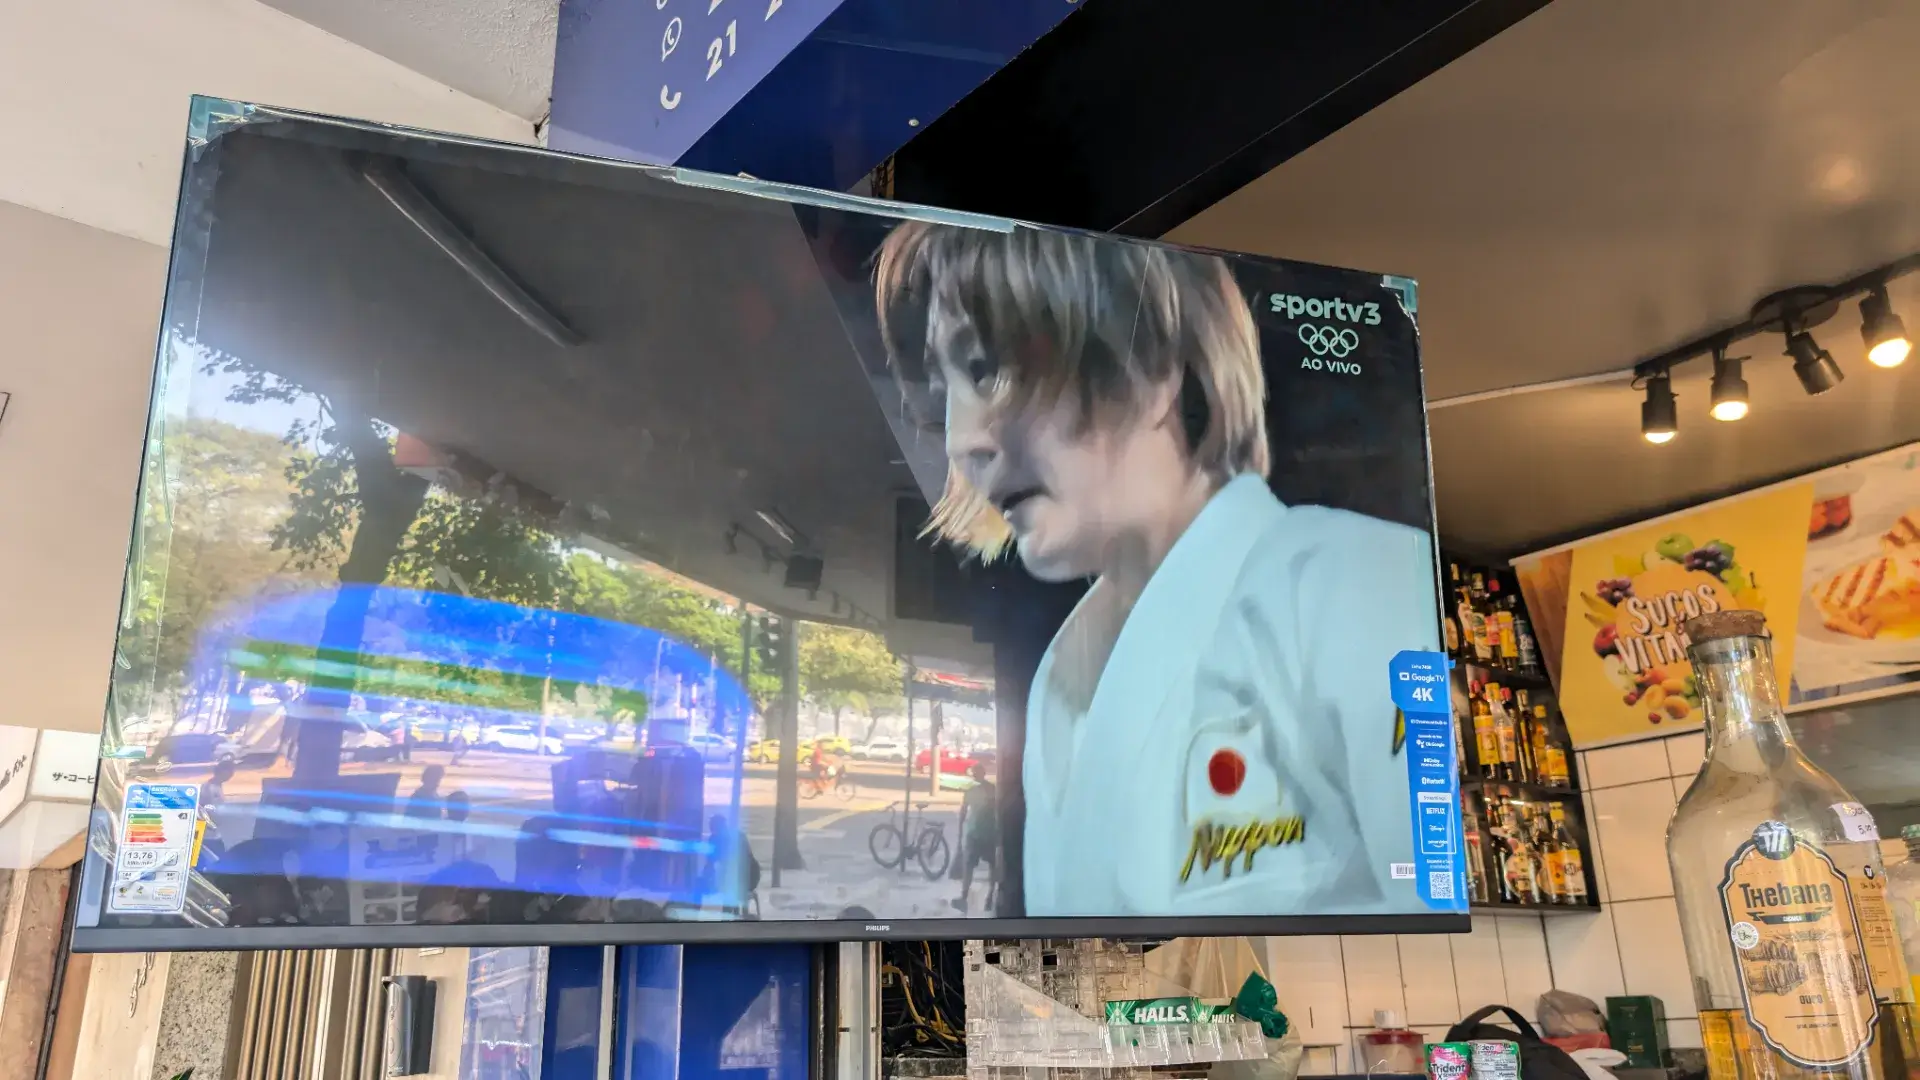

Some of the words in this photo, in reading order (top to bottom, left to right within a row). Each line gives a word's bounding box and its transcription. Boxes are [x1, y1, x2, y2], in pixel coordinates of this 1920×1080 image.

[706, 19, 737, 82] 21
[1270, 293, 1382, 326] sportv3
[1301, 357, 1323, 371] AO
[1325, 359, 1362, 375] VIVO
[1626, 584, 1720, 635] SUCOS
[1411, 673, 1434, 684] Google
[1412, 687, 1434, 701] 4K
[127, 851, 153, 860] 13,76
[1431, 1061, 1466, 1074] Trident
